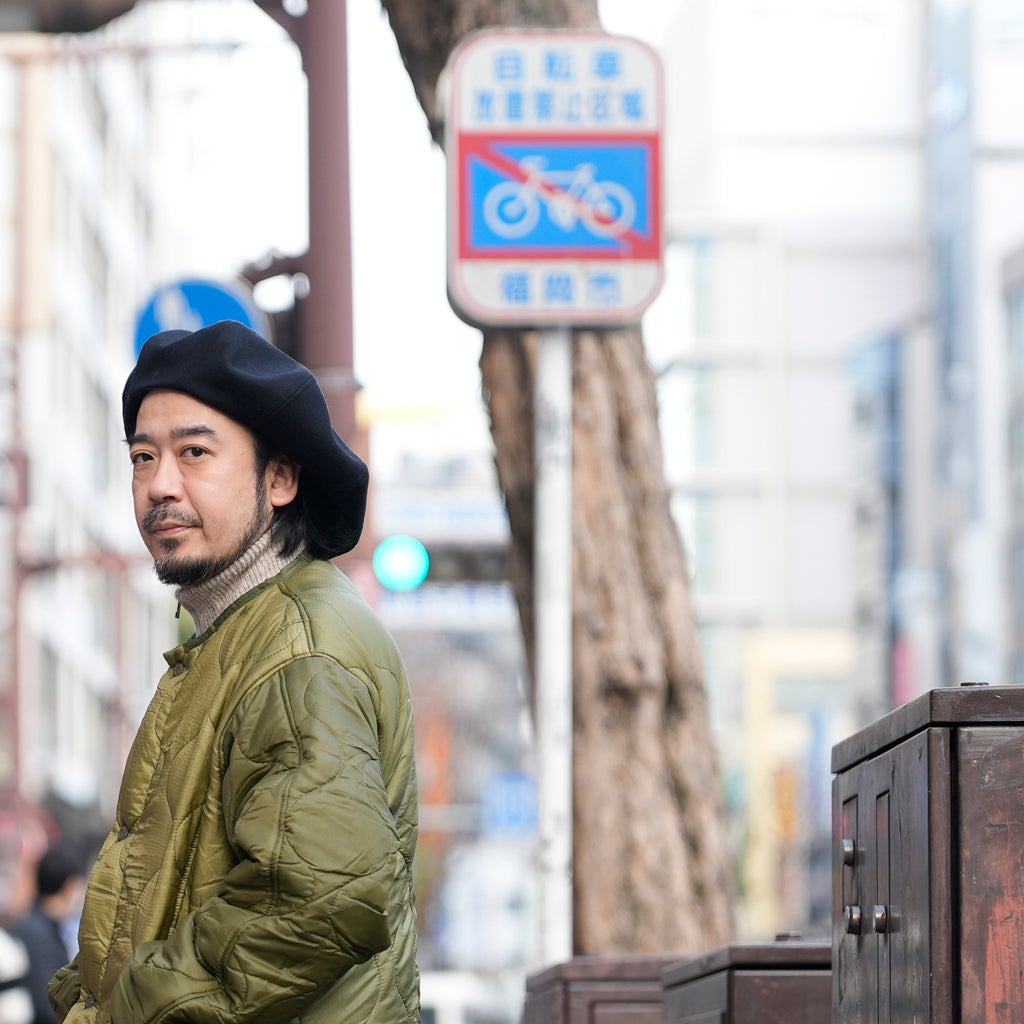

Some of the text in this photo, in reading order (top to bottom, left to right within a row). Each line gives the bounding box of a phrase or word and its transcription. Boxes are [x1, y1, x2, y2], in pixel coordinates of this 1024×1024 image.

[495, 50, 623, 80] 自転車
[503, 271, 619, 305] 福岡市
